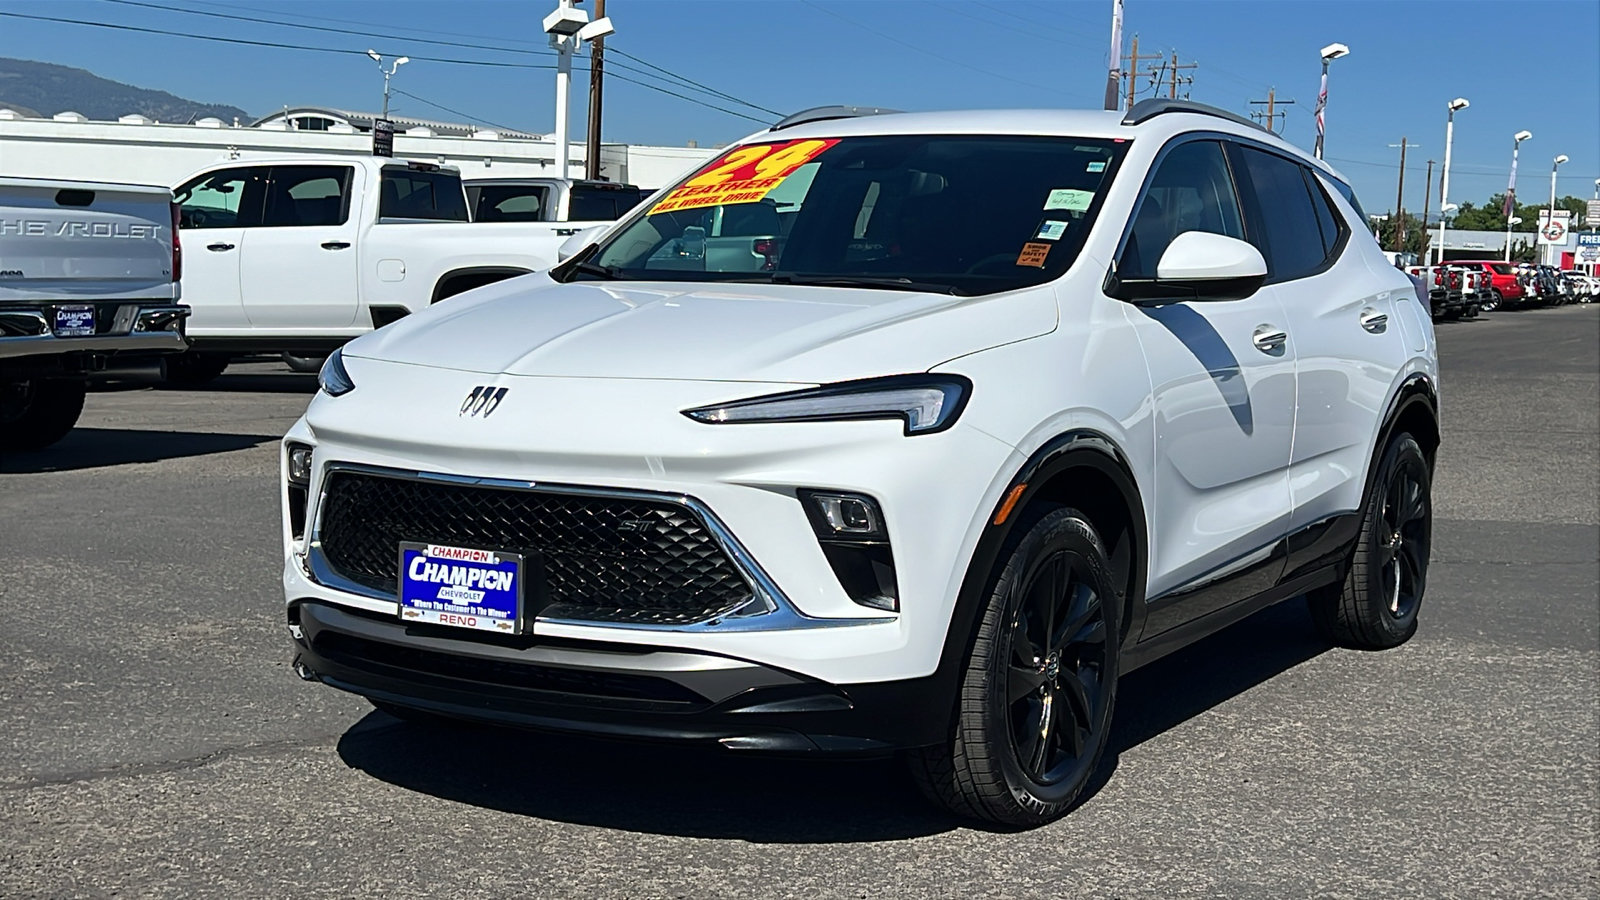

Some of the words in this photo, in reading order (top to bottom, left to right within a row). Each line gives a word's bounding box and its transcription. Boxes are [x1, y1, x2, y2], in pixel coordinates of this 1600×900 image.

[685, 140, 827, 187] 24
[669, 177, 780, 200] LEATHER
[652, 200, 675, 212] ALL
[679, 195, 722, 208] WHEEL
[721, 191, 765, 202] DRIVE
[57, 310, 93, 321] CHAMPION
[617, 519, 656, 531] ST
[432, 546, 489, 562] CHAMPION
[408, 556, 514, 592] CHAMPION
[440, 589, 481, 600] CHEVROLET
[433, 601, 444, 610] The
[444, 603, 470, 613] Customer
[470, 606, 476, 614] Is
[477, 606, 487, 616] The
[440, 614, 477, 627] RENO
